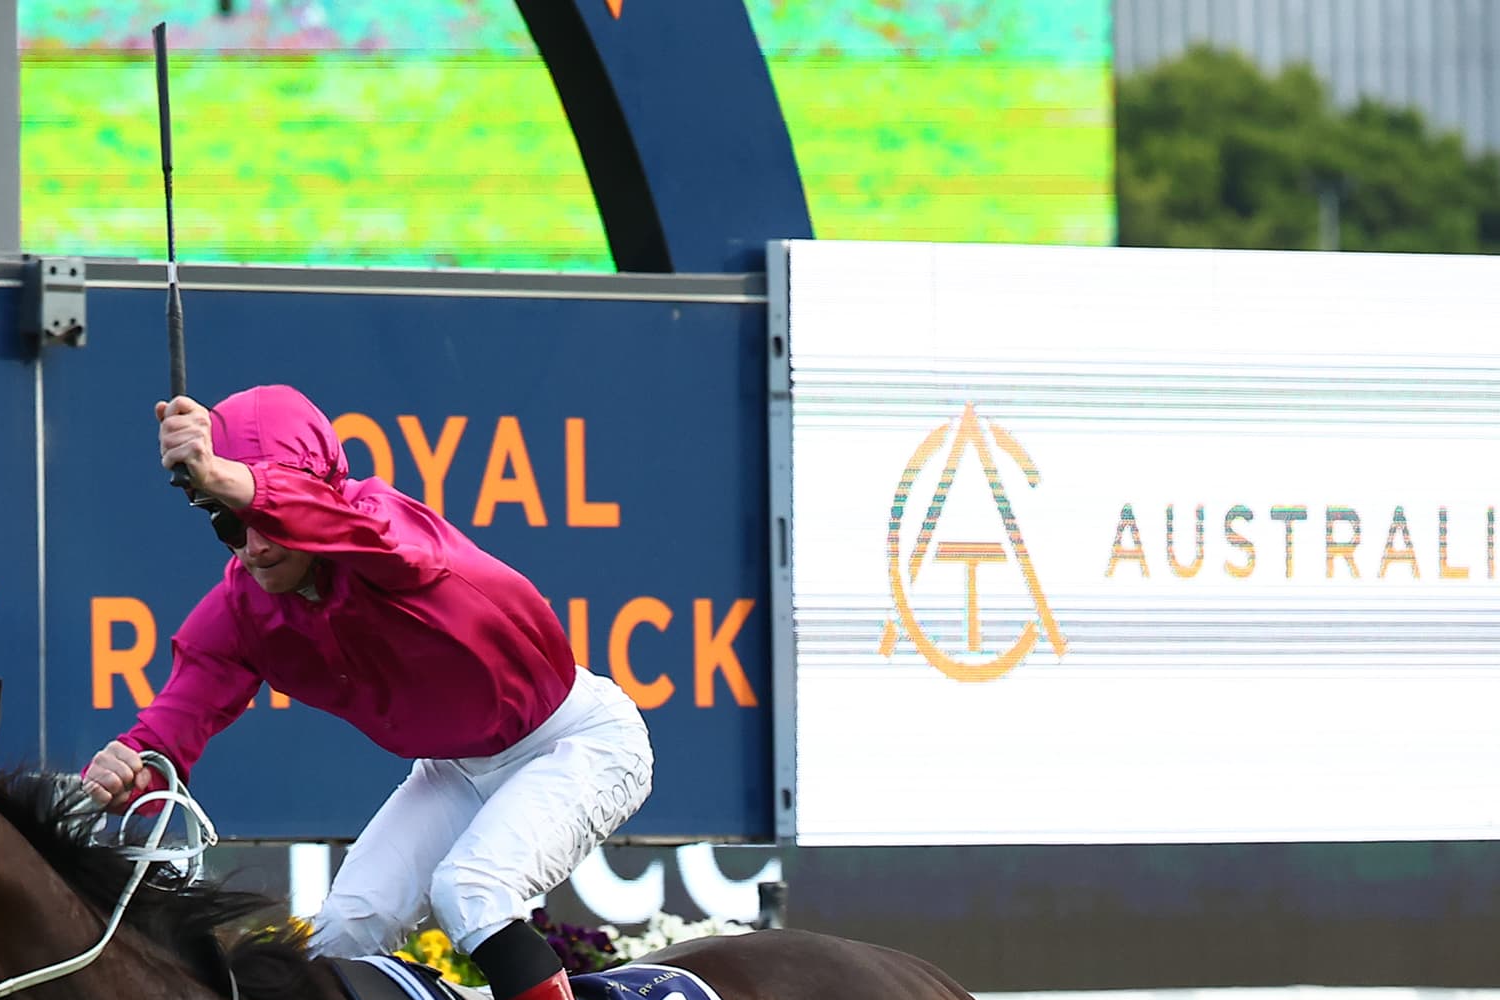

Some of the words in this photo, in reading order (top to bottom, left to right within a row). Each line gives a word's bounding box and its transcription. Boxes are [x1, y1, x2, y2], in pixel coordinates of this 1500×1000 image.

[330, 414, 618, 526] OYAL
[1104, 502, 1494, 579] AUSTRALI
[90, 596, 758, 710] RICK
